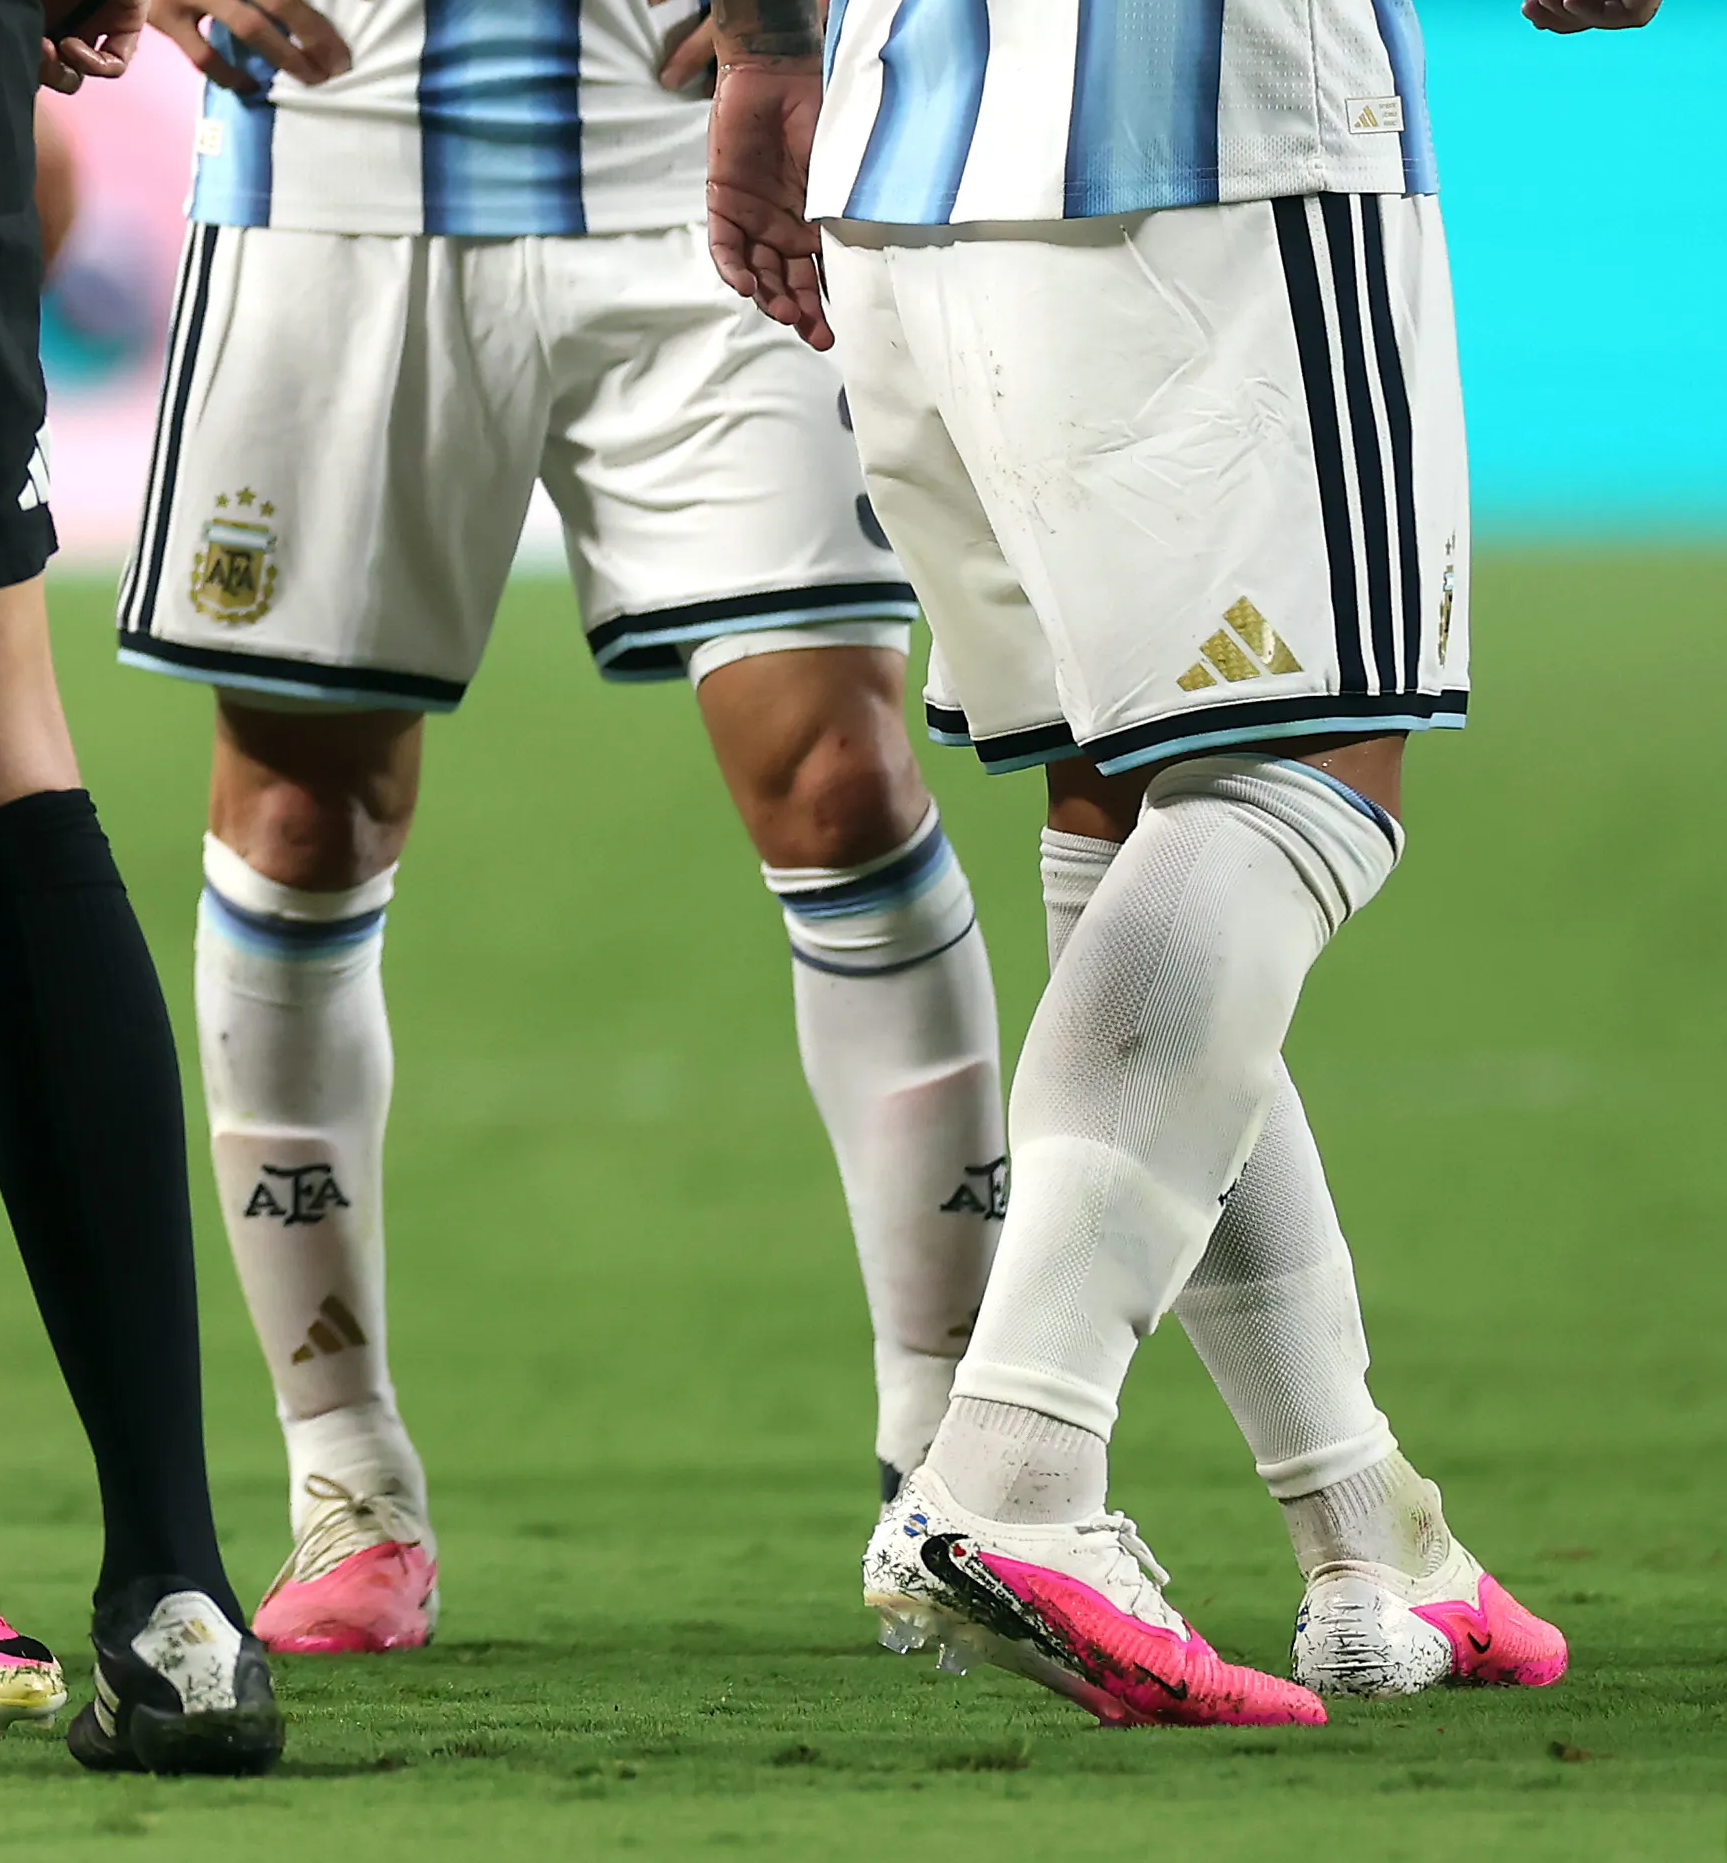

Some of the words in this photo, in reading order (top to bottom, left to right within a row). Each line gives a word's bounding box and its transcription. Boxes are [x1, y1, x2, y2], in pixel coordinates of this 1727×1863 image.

[205, 549, 254, 598] AFA
[243, 1162, 351, 1228] AFA
[939, 1155, 1007, 1221] AF
